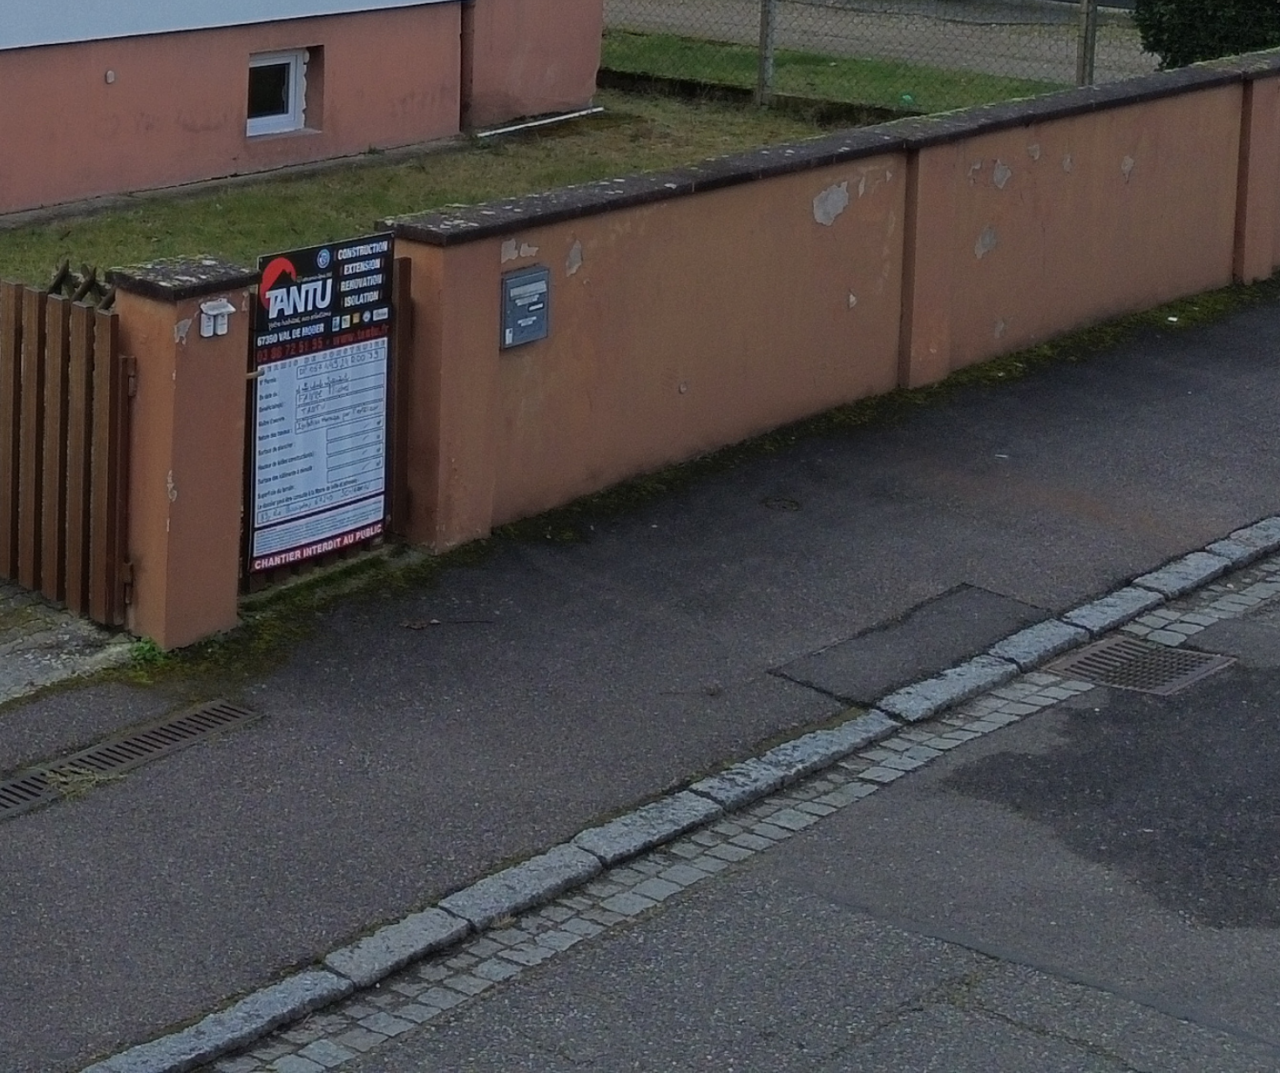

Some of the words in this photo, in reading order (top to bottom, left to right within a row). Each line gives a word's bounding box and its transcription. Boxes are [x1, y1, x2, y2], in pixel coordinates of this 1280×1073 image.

[338, 241, 388, 260] CONSTRUCTION
[344, 258, 381, 275] EXTENSION
[265, 278, 333, 319] TANTU
[344, 290, 379, 307] ISOLATION
[278, 330, 291, 342] VAL
[255, 547, 302, 570] CHANTIER
[303, 536, 341, 558] INTERDIT
[343, 534, 354, 547] AU
[356, 523, 382, 543] PUBLIC
